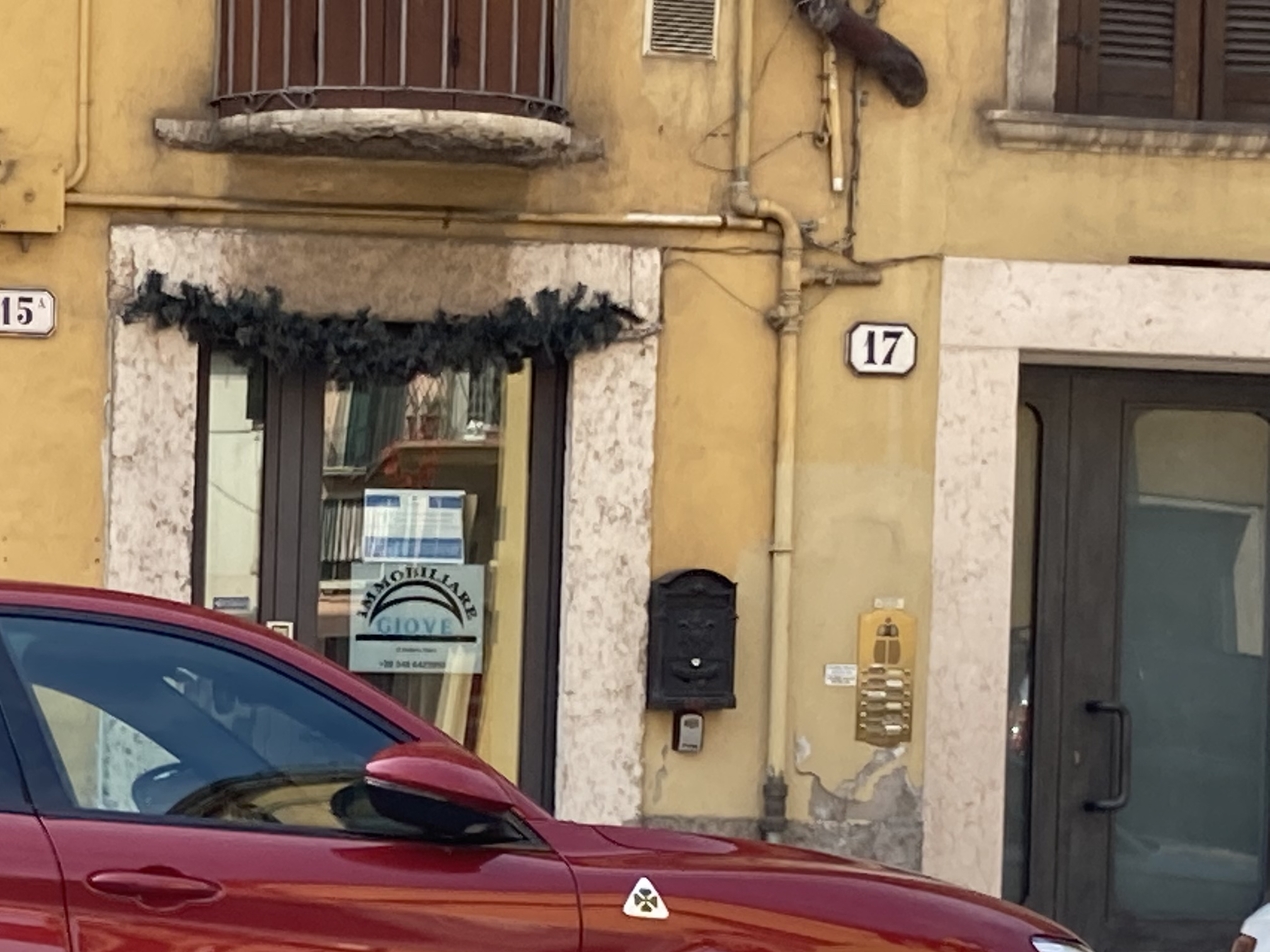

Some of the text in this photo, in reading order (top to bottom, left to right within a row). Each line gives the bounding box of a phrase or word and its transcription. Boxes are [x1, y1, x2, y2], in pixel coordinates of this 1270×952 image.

[863, 330, 904, 365] 17
[357, 566, 478, 621] IMMOBILIARE
[377, 617, 452, 635] GIOVE
